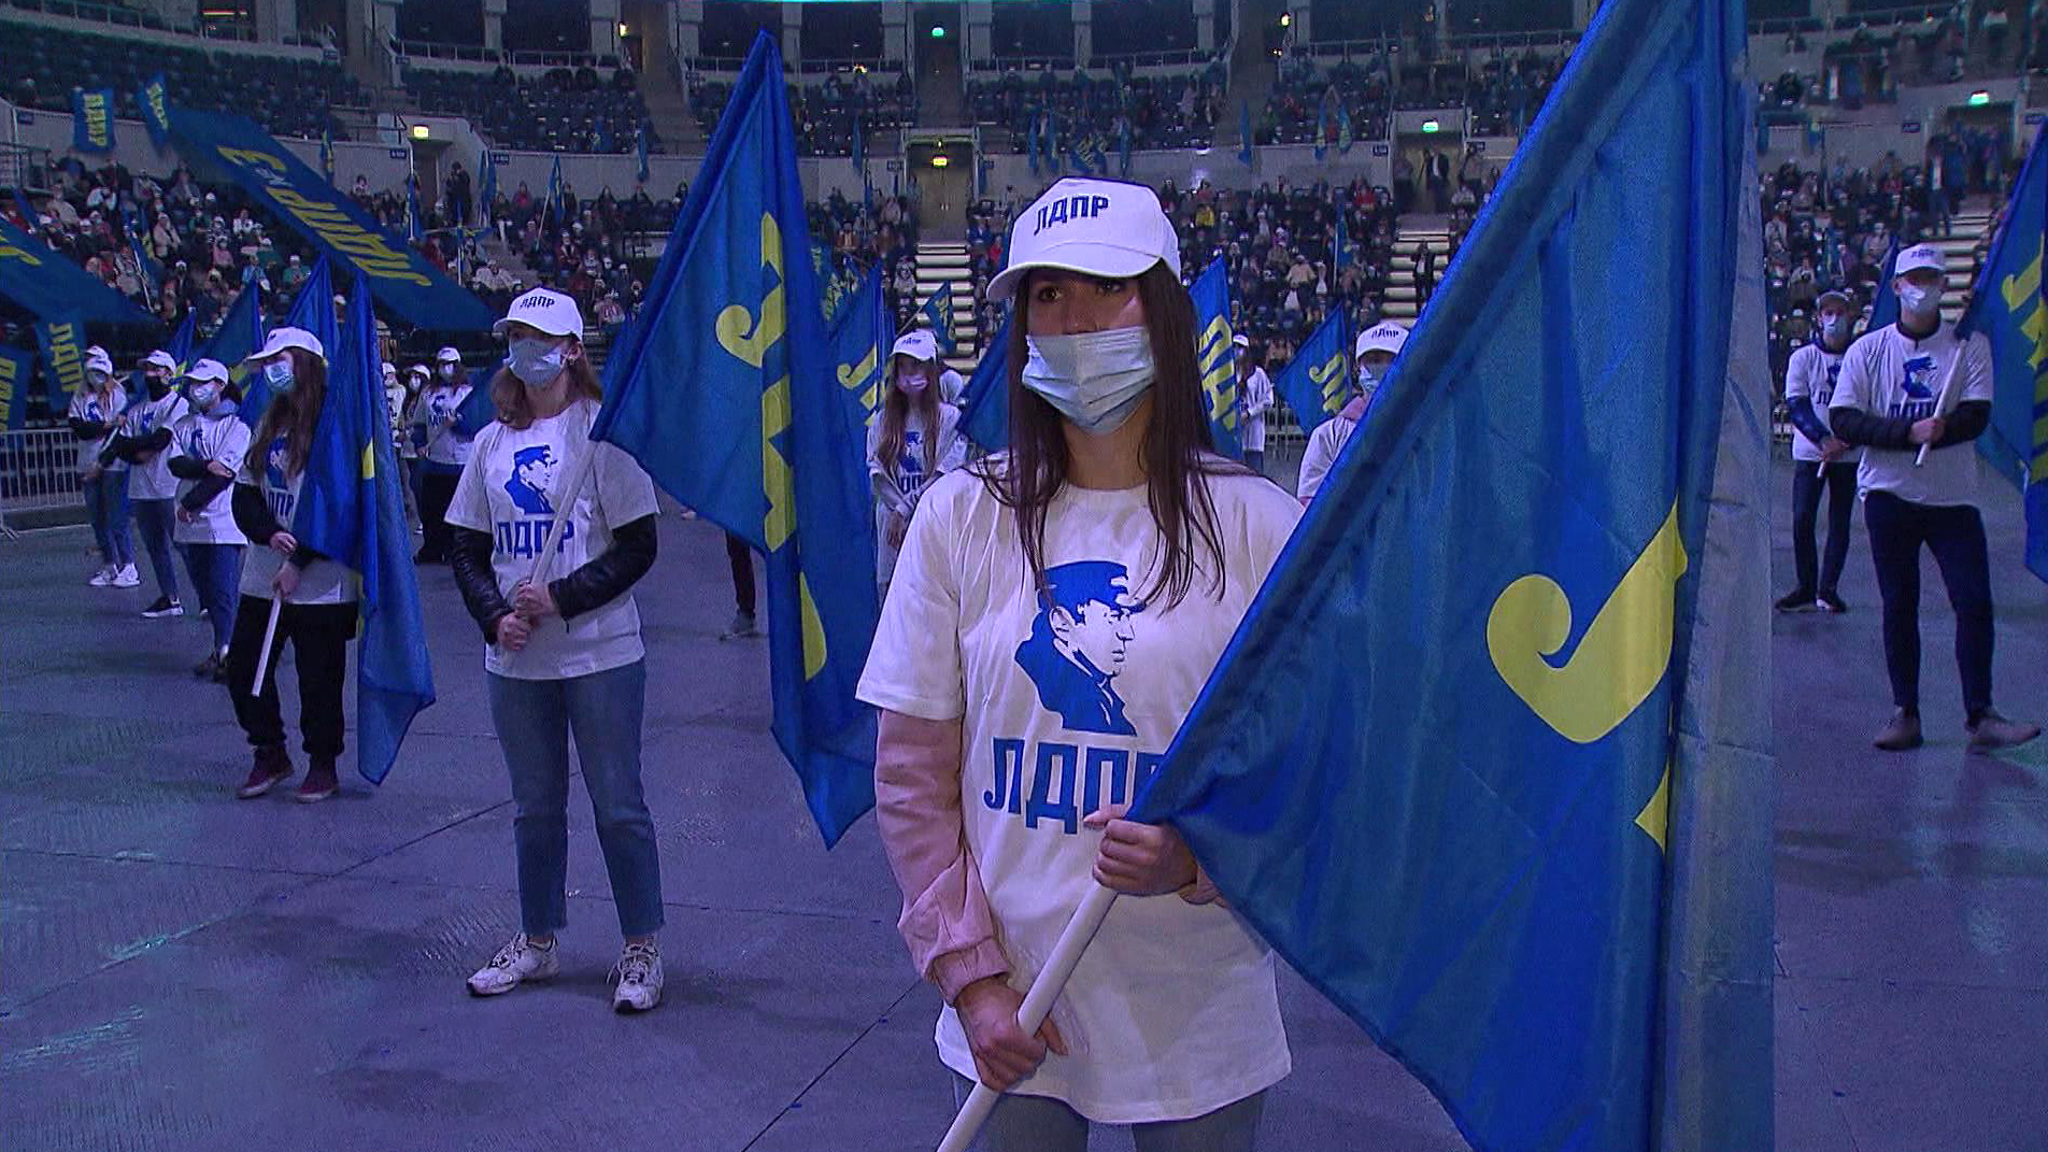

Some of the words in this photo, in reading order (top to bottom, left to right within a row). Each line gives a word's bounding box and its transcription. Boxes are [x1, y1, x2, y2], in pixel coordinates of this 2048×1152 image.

[1033, 195, 1109, 236] ЛДПР
[267, 187, 432, 287] ЛДПР
[520, 296, 555, 308] ЛДПР
